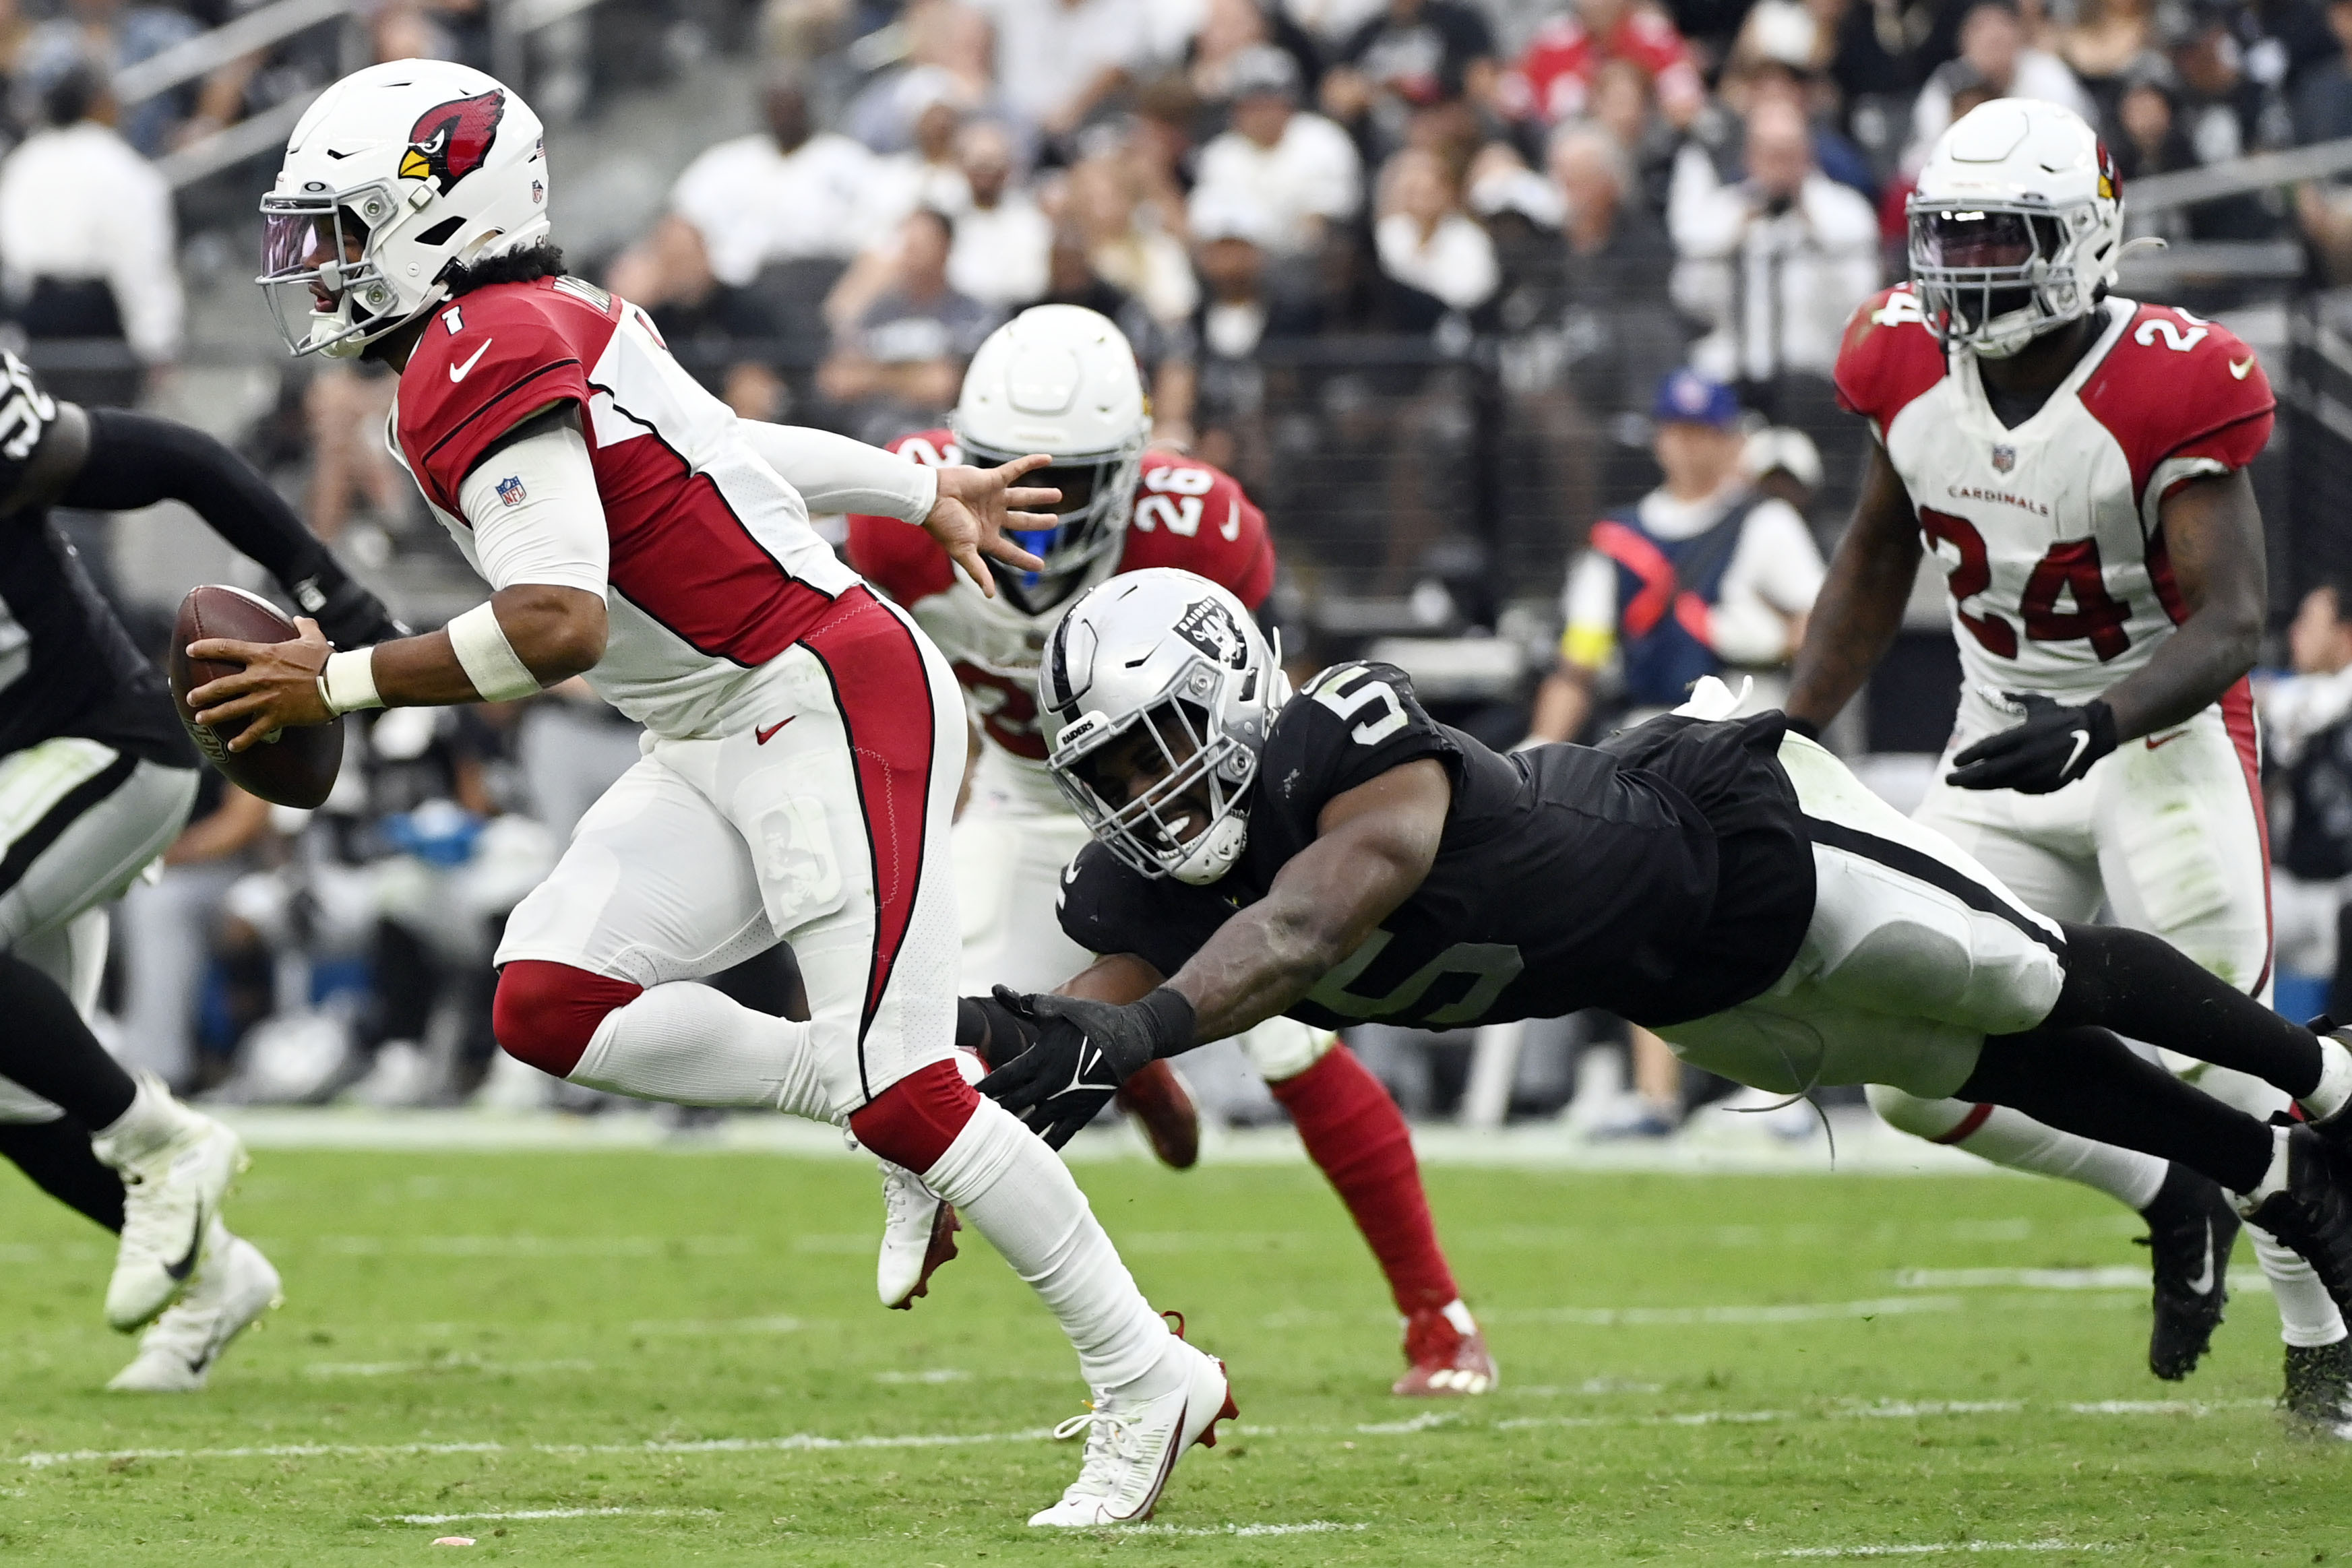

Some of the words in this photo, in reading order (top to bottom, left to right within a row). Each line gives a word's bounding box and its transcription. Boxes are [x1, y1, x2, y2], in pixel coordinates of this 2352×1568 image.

[440, 305, 464, 336] 1
[1871, 281, 1922, 329] 4
[2134, 307, 2209, 352] 2
[503, 486, 524, 505] NFL
[1134, 466, 1214, 538] 26
[1947, 484, 2049, 518] CARDINALS
[1919, 504, 2132, 662] 24
[1178, 597, 1216, 632] RAIDERS
[1311, 665, 1409, 746] 5
[1061, 720, 1094, 745] RAIDERS
[1305, 927, 1525, 1024] 5
